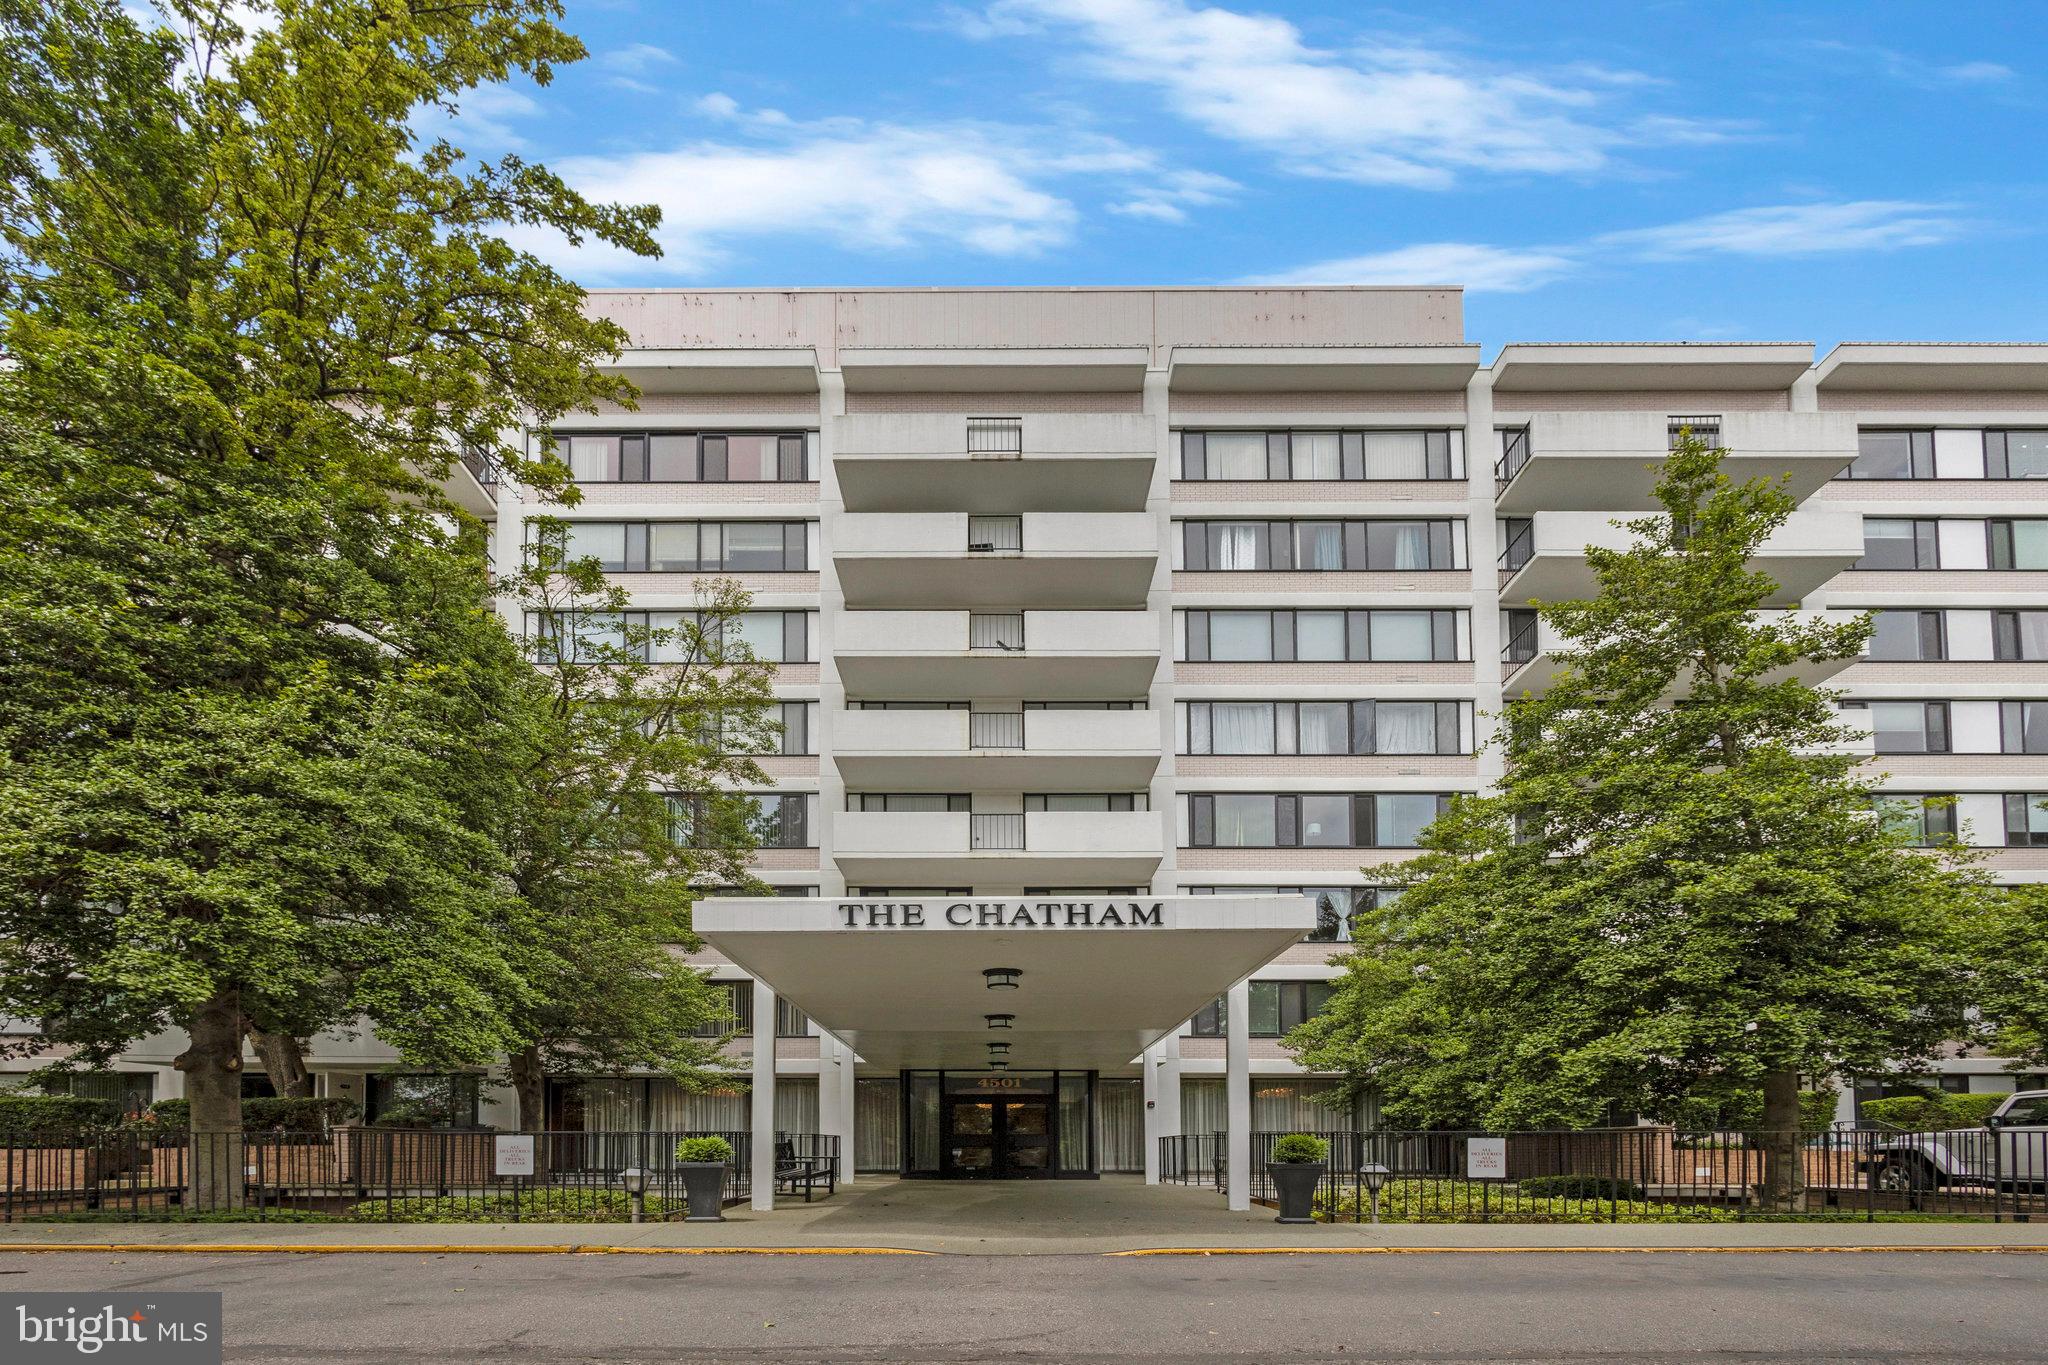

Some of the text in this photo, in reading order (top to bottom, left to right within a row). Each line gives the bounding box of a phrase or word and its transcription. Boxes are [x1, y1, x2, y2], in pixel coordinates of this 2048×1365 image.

[838, 903, 1165, 926] THE CHATHAM
[977, 1078, 1022, 1088] 4501
